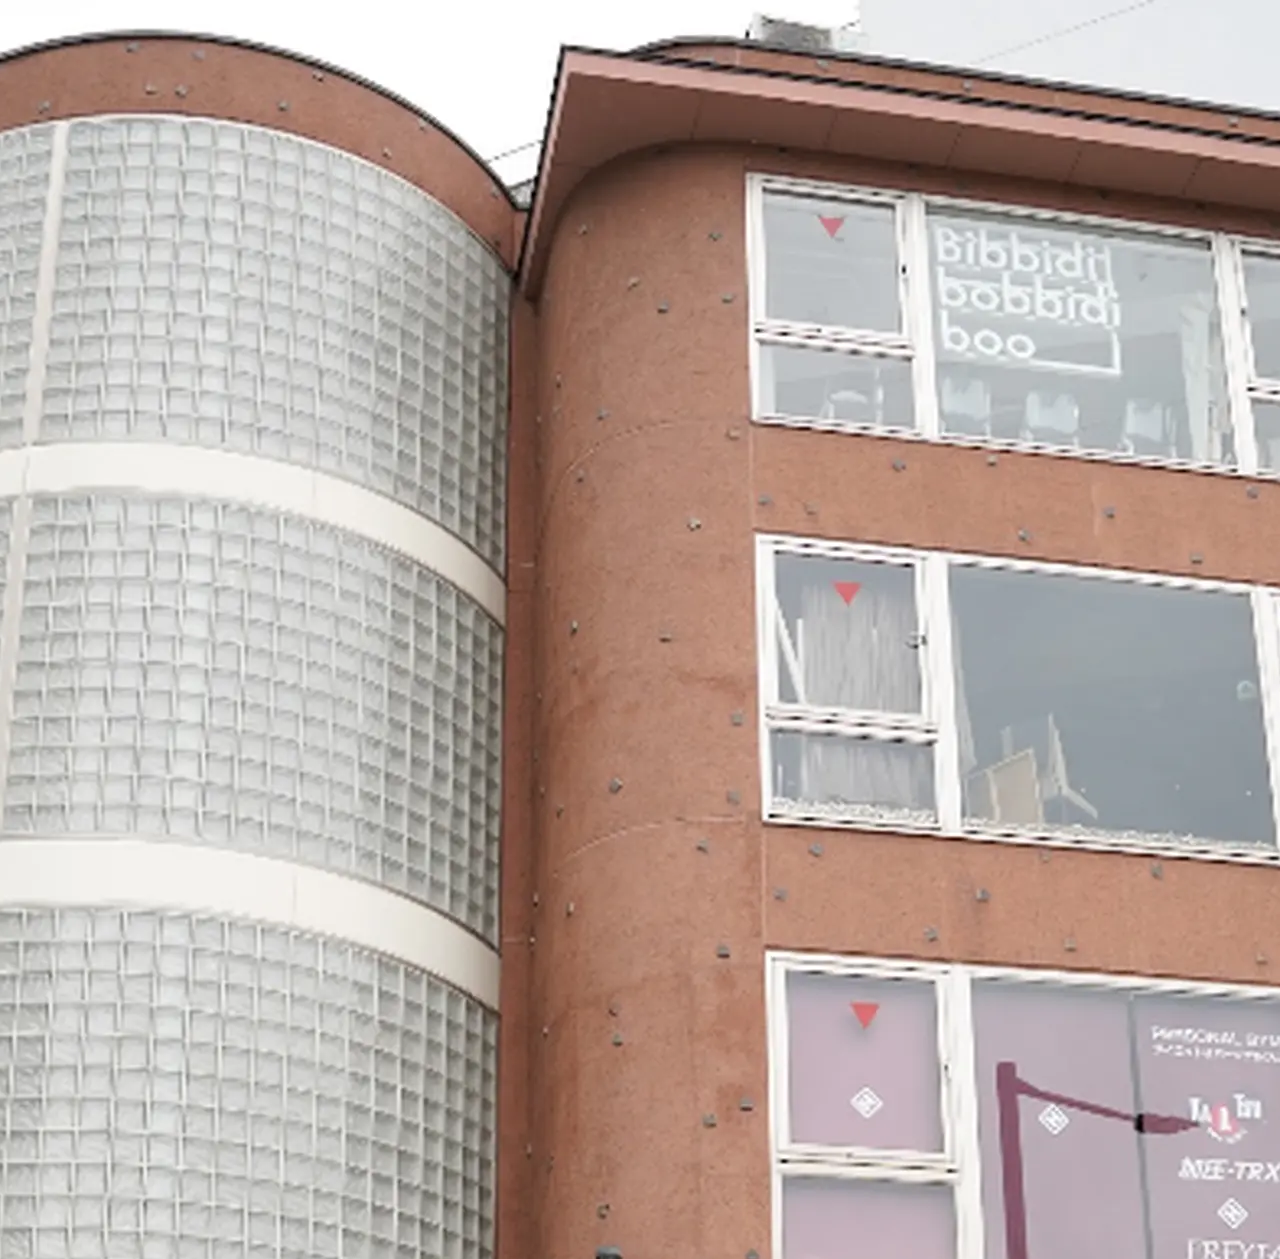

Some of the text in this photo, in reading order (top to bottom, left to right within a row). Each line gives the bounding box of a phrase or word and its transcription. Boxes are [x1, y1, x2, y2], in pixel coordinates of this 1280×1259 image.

[936, 226, 1098, 281] Bibbidi
[936, 266, 1121, 327] bobbidi
[940, 310, 1036, 358] boo
